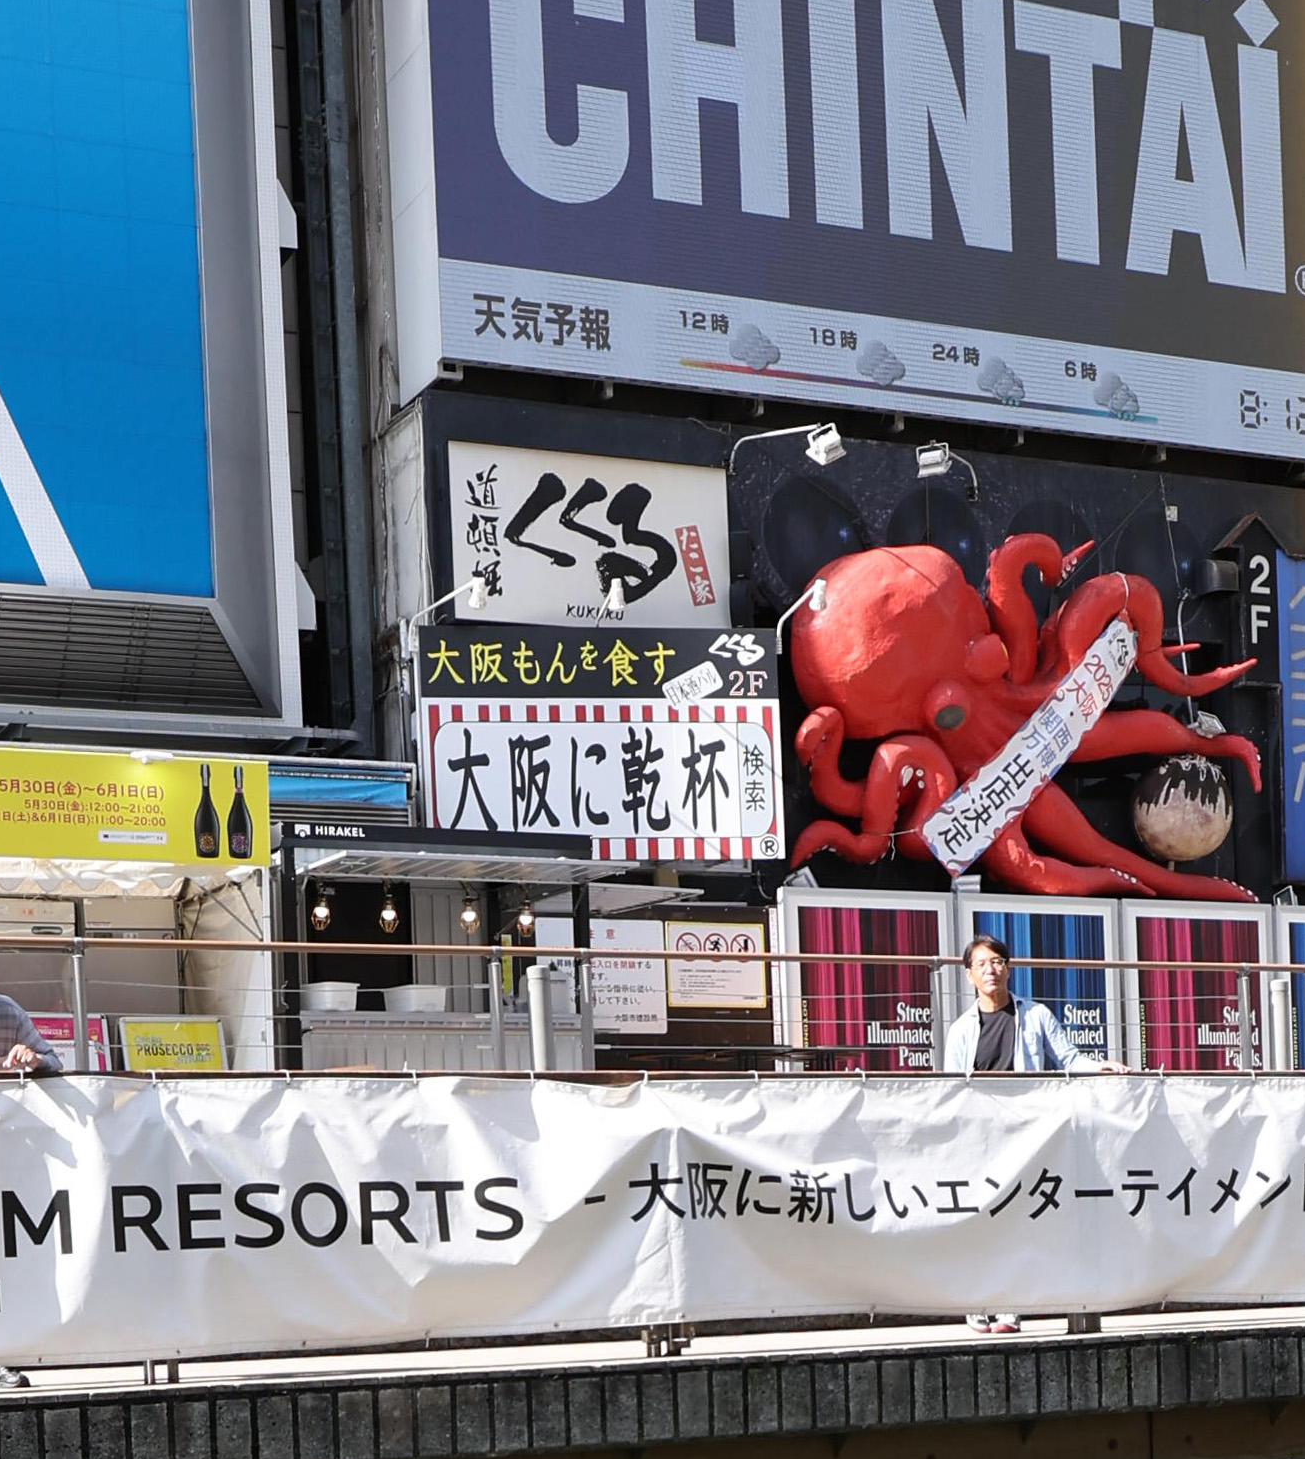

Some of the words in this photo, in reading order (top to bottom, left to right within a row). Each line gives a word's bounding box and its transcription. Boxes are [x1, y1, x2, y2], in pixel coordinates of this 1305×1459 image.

[473, 292, 612, 352] 天気予報
[678, 309, 730, 335] 12時
[808, 326, 858, 351] 18時
[931, 342, 980, 367] 24時
[1064, 360, 1098, 383] 6時
[503, 472, 678, 604] くくる
[427, 638, 676, 687] 大阪もんを食す
[728, 670, 768, 696] 2F
[1083, 654, 1114, 702] 2025
[447, 727, 730, 834] 大阪に乾杯
[742, 743, 766, 813] 検索
[937, 753, 1035, 855] 出店決定
[314, 825, 366, 838] HIRAKEL
[896, 1001, 933, 1023] Stree
[1063, 1003, 1102, 1026] Street
[1222, 1005, 1257, 1026] Strt
[136, 1043, 194, 1056] PROSECCO
[111, 1177, 525, 1253] RESORTS
